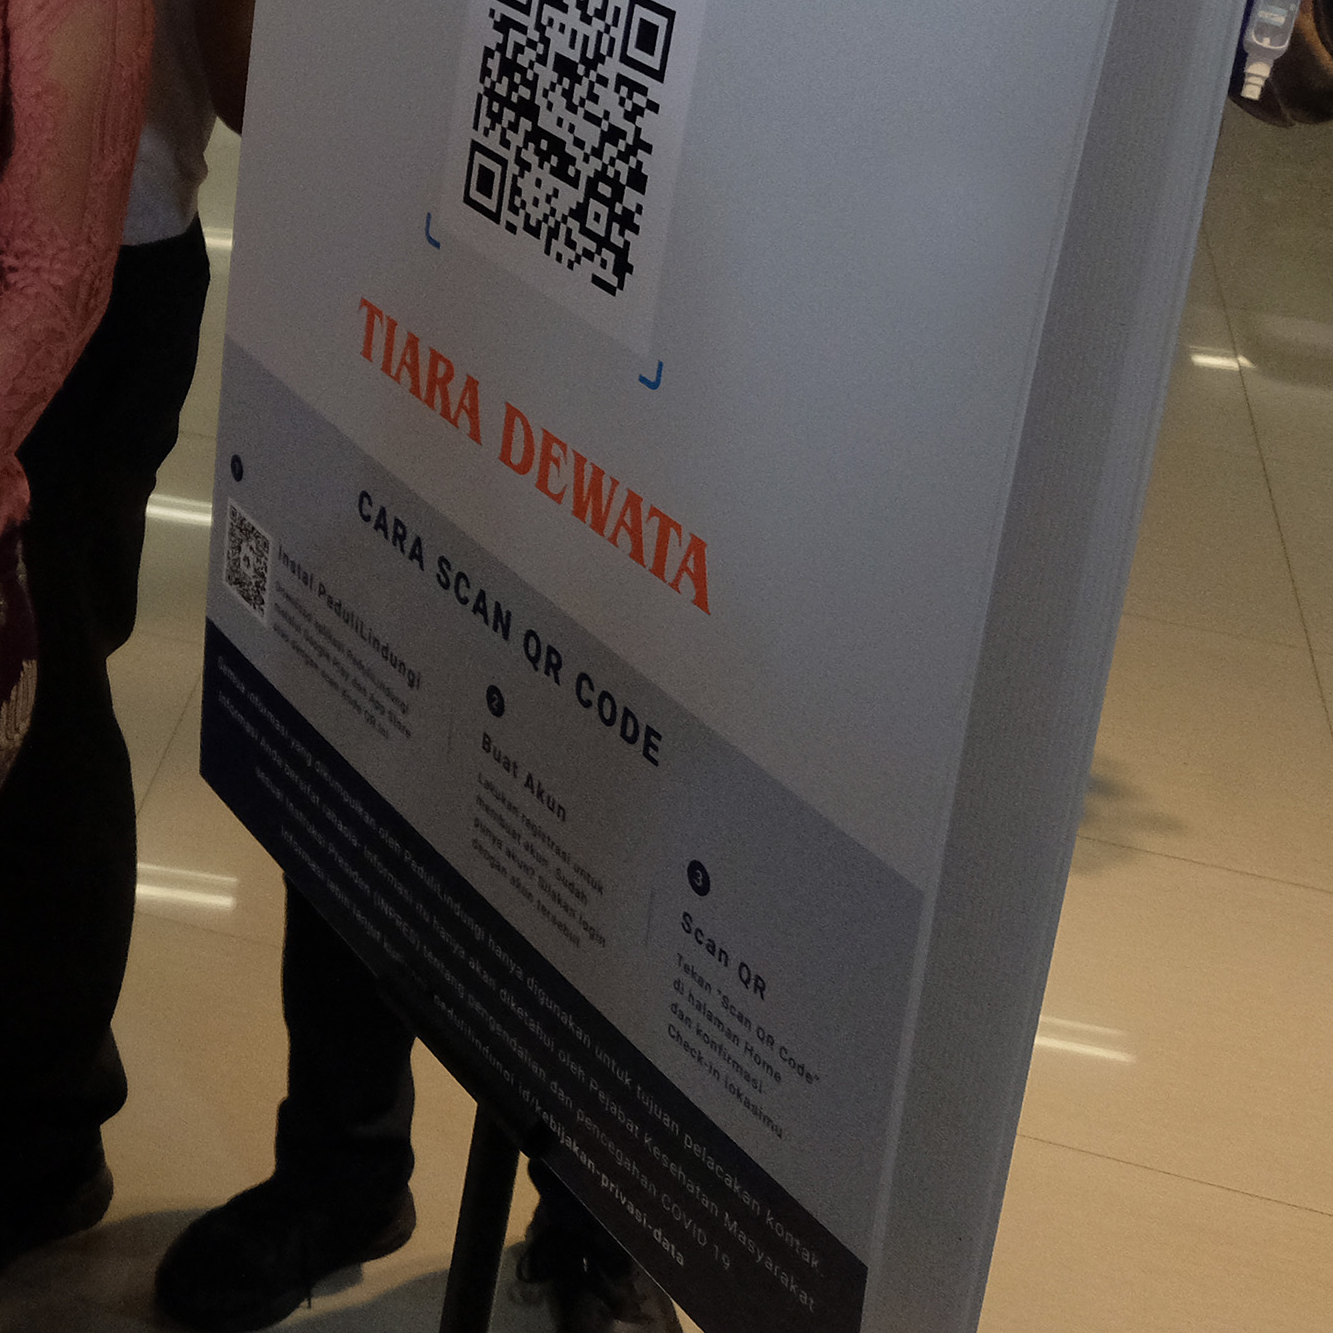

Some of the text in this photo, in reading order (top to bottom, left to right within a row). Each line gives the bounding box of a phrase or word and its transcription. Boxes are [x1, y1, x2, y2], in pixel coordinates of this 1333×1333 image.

[357, 296, 713, 616] TIARA DEWATA
[276, 542, 421, 695] Instal PeduliLindungi
[356, 485, 664, 771] CARA SCAN QR CODE
[477, 770, 604, 897] Lakukan registrasi untuk
[481, 730, 567, 825] Buat Akun
[554, 865, 588, 909] Sudah
[578, 911, 607, 953] login
[675, 949, 713, 997] Tekan
[755, 1021, 776, 1055] QR
[679, 906, 768, 1007] Scan QR
[378, 821, 401, 858] oleh
[487, 932, 523, 985] hanya
[525, 970, 591, 1054] digunakan
[595, 1040, 632, 1091] untuk
[636, 1080, 680, 1141] tujuan
[682, 1125, 762, 1223] pelacakan
[666, 1019, 783, 1143] Check-in lokasimu
[669, 997, 763, 1098] dan konfirmasi
[672, 972, 783, 1088] di halaman Home
[422, 940, 465, 1001] tentang
[467, 987, 547, 1087] pengendalian
[549, 1074, 573, 1114] dan
[575, 1100, 657, 1204] pencegahan
[660, 1187, 709, 1252] COVID
[711, 1239, 731, 1275] 19
[432, 915, 466, 964] hanya
[468, 952, 496, 994] akan
[498, 982, 555, 1055] diketahui
[557, 1043, 586, 1085] oleh
[588, 1074, 640, 1143] Pejabat
[643, 1129, 720, 1223] Kesehatan
[722, 1206, 816, 1322] Masyarakat
